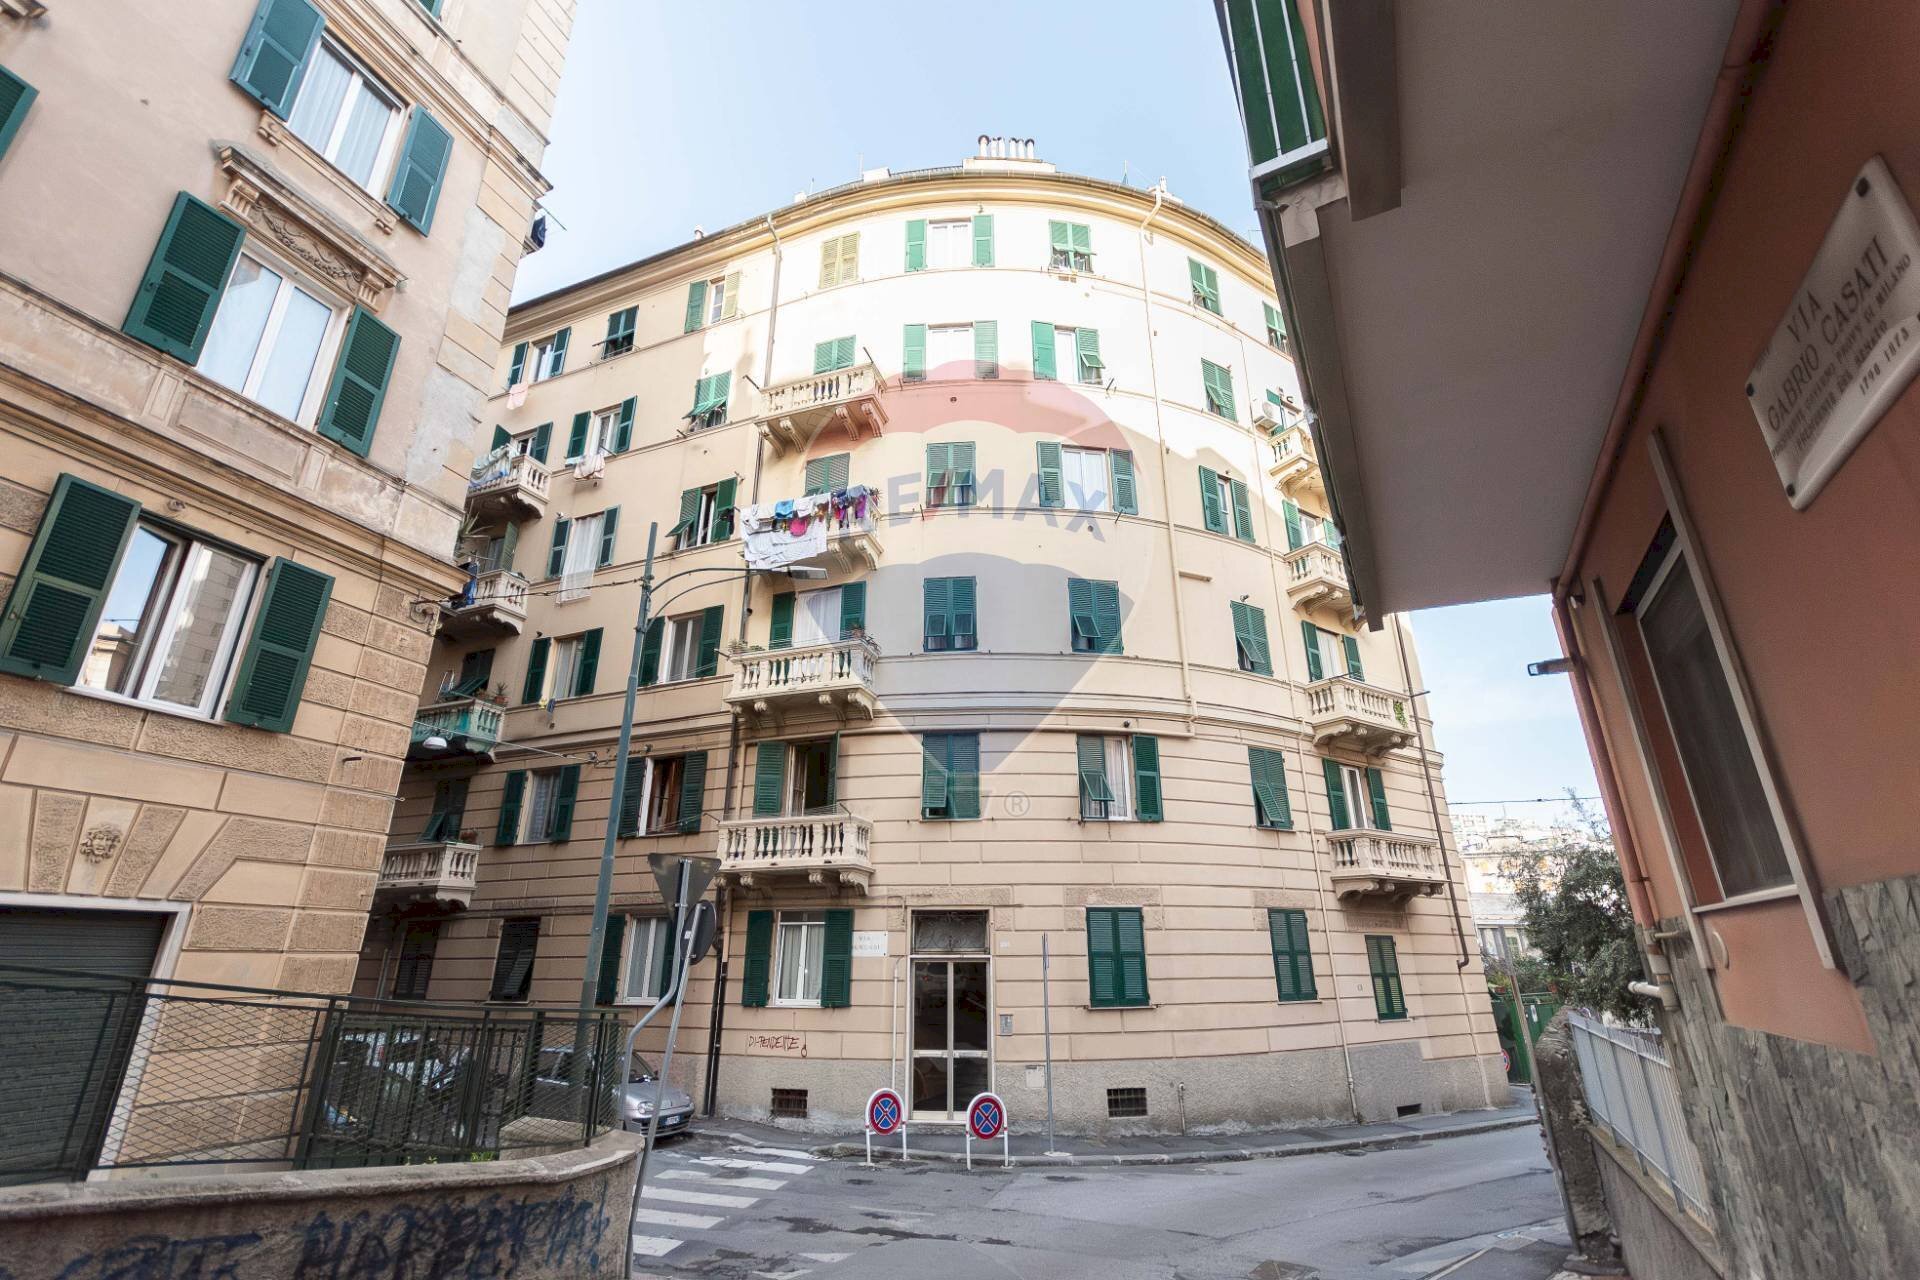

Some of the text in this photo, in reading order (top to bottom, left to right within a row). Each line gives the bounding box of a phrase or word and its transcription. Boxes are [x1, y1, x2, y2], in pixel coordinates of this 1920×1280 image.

[1875, 254, 1912, 311] MILANO
[1767, 235, 1889, 432] GABRIO CASATI
[1787, 290, 1822, 342] VIA
